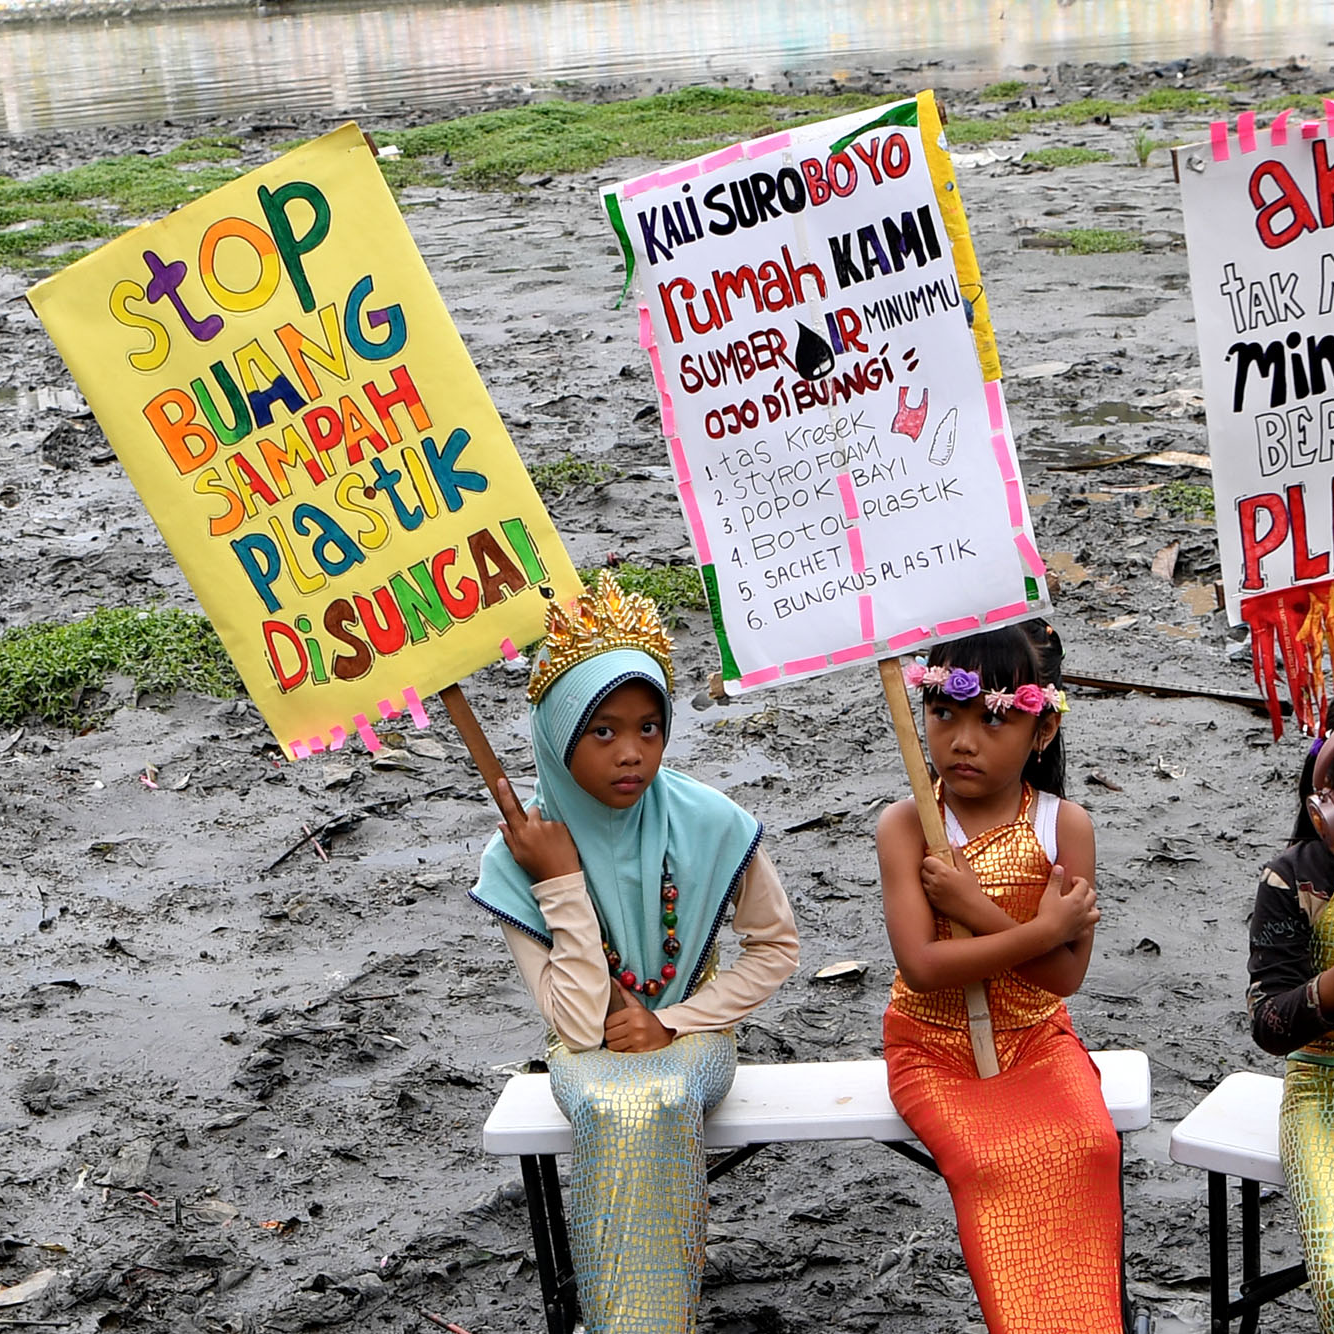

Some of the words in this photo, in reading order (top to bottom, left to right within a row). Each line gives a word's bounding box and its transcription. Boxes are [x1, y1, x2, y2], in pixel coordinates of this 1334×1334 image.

[702, 132, 911, 236] SUROBOYO
[109, 181, 331, 372] StOP
[657, 245, 826, 343] rumah
[828, 205, 942, 290] KAMI
[1219, 262, 1306, 335] tAK
[143, 274, 407, 476] BUANG
[679, 327, 798, 394] SUMBER
[863, 275, 960, 333] MINUMMU
[194, 364, 434, 538] SAMPAH
[704, 398, 759, 439] OJO
[704, 465, 719, 481] 1.
[784, 410, 876, 452] Kresek
[713, 489, 730, 506] 2.
[721, 517, 738, 535] 3.
[851, 456, 909, 488] BAYI
[730, 547, 749, 569] 4.
[738, 580, 757, 602] 5.
[764, 545, 843, 590] SACHET
[746, 609, 768, 631] 6.
[772, 567, 878, 619] BUNGKUS
[879, 538, 978, 582] PLASTIK
